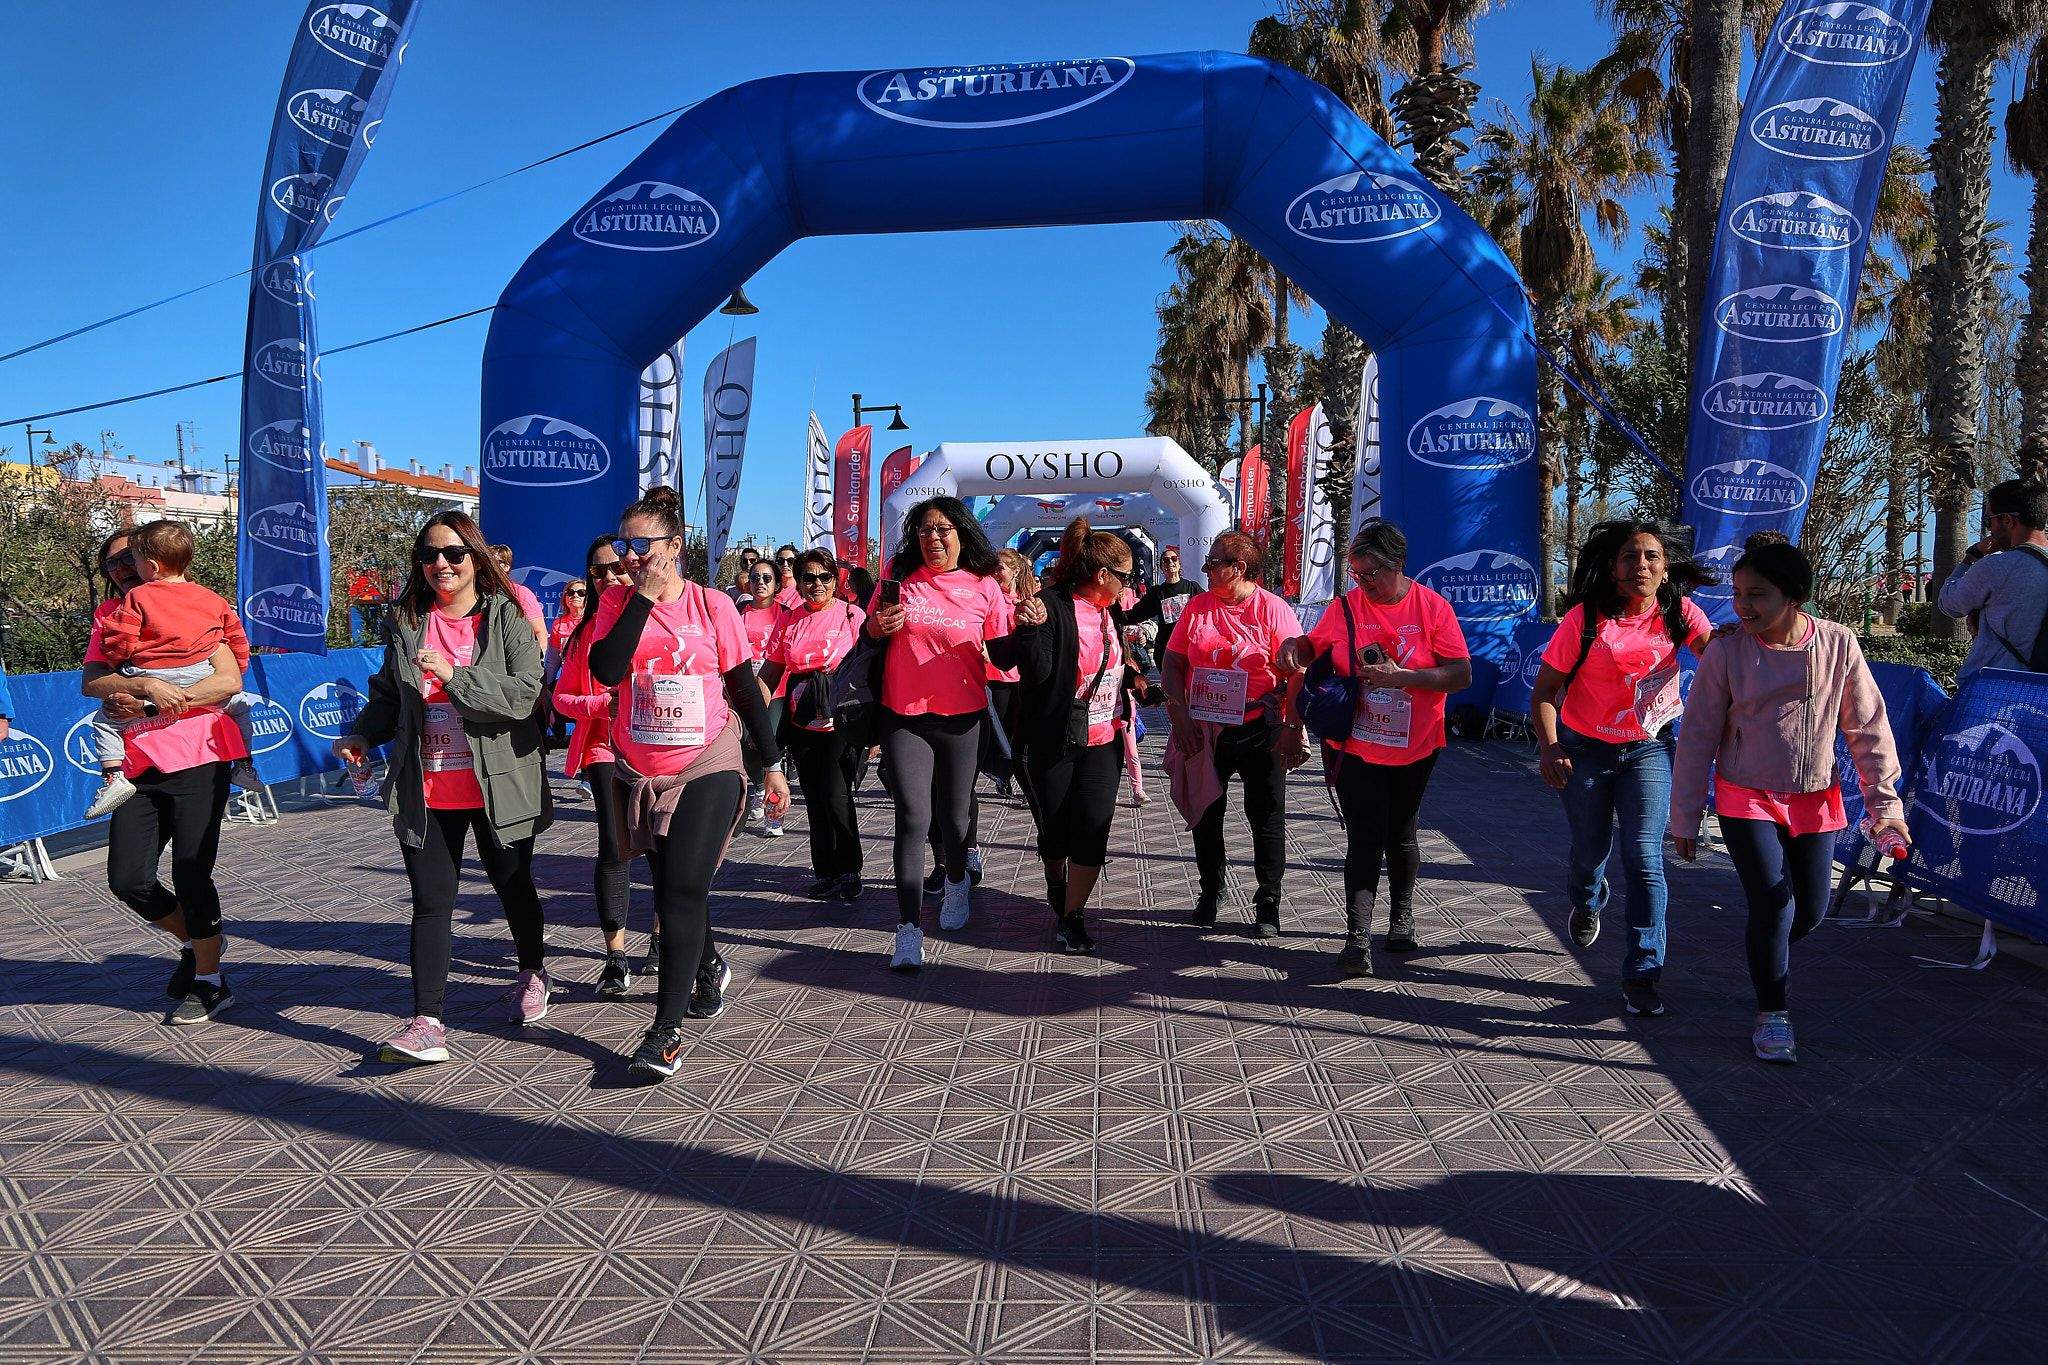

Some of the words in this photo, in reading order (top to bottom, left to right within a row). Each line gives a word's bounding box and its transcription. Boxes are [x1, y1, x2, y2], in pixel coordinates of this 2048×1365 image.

[1811, 20, 1853, 31] CENTRAL
[1857, 25, 1899, 36] LECHERA
[1787, 20, 1899, 55] ASTURIANA
[923, 64, 1010, 75] CENTRAL
[1015, 57, 1104, 70] LECHERA
[876, 64, 1114, 103] ASTURIANA
[1783, 115, 1827, 127] CENTRAL
[1830, 120, 1872, 132] LECHERA
[1758, 115, 1872, 150] ASTURIANA
[1321, 193, 1374, 207] CENTRAL
[1377, 192, 1424, 202] LECHERA
[604, 204, 649, 213] CENTRAL
[653, 203, 703, 213] LECHERA
[1298, 202, 1433, 230] ASTURIANA
[580, 210, 709, 235] ASTURIANA
[1762, 208, 1805, 219] CENTRAL
[1809, 212, 1850, 225] LECHERA
[1737, 208, 1850, 242] ASTURIANA
[1744, 301, 1789, 311] CENTRAL
[1792, 303, 1837, 313] LECHERA
[1722, 302, 1837, 330] ASTURIANA
[1729, 389, 1773, 399] CENTRAL
[1776, 390, 1818, 400] LECHERA
[1710, 390, 1818, 418] ASTURIANA
[1439, 422, 1489, 431] CENTRAL
[499, 439, 542, 447] CENTRAL
[547, 440, 596, 450] LECHERA
[1417, 426, 1532, 454] ASTURIANA
[485, 442, 601, 471] ASTURIANA
[985, 451, 1123, 481] OYSHO
[847, 448, 862, 522] Santander
[1163, 479, 1205, 489] OYSHO
[1716, 476, 1755, 485] CENTRAL
[1757, 478, 1797, 488] LECHERA
[906, 487, 946, 495] OYSHO
[1246, 466, 1255, 527] Santander
[1697, 476, 1797, 505] ASTURIANA
[1442, 574, 1491, 583] CENTRAL
[907, 596, 928, 605] HOY
[907, 613, 920, 623] AS
[923, 616, 966, 629] CHICAS
[1206, 692, 1227, 702] 016
[1646, 694, 1664, 711] 016
[654, 706, 683, 718] 016
[1369, 712, 1390, 723] 016
[423, 733, 450, 745] 016
[1596, 725, 1625, 737] CARRERA
